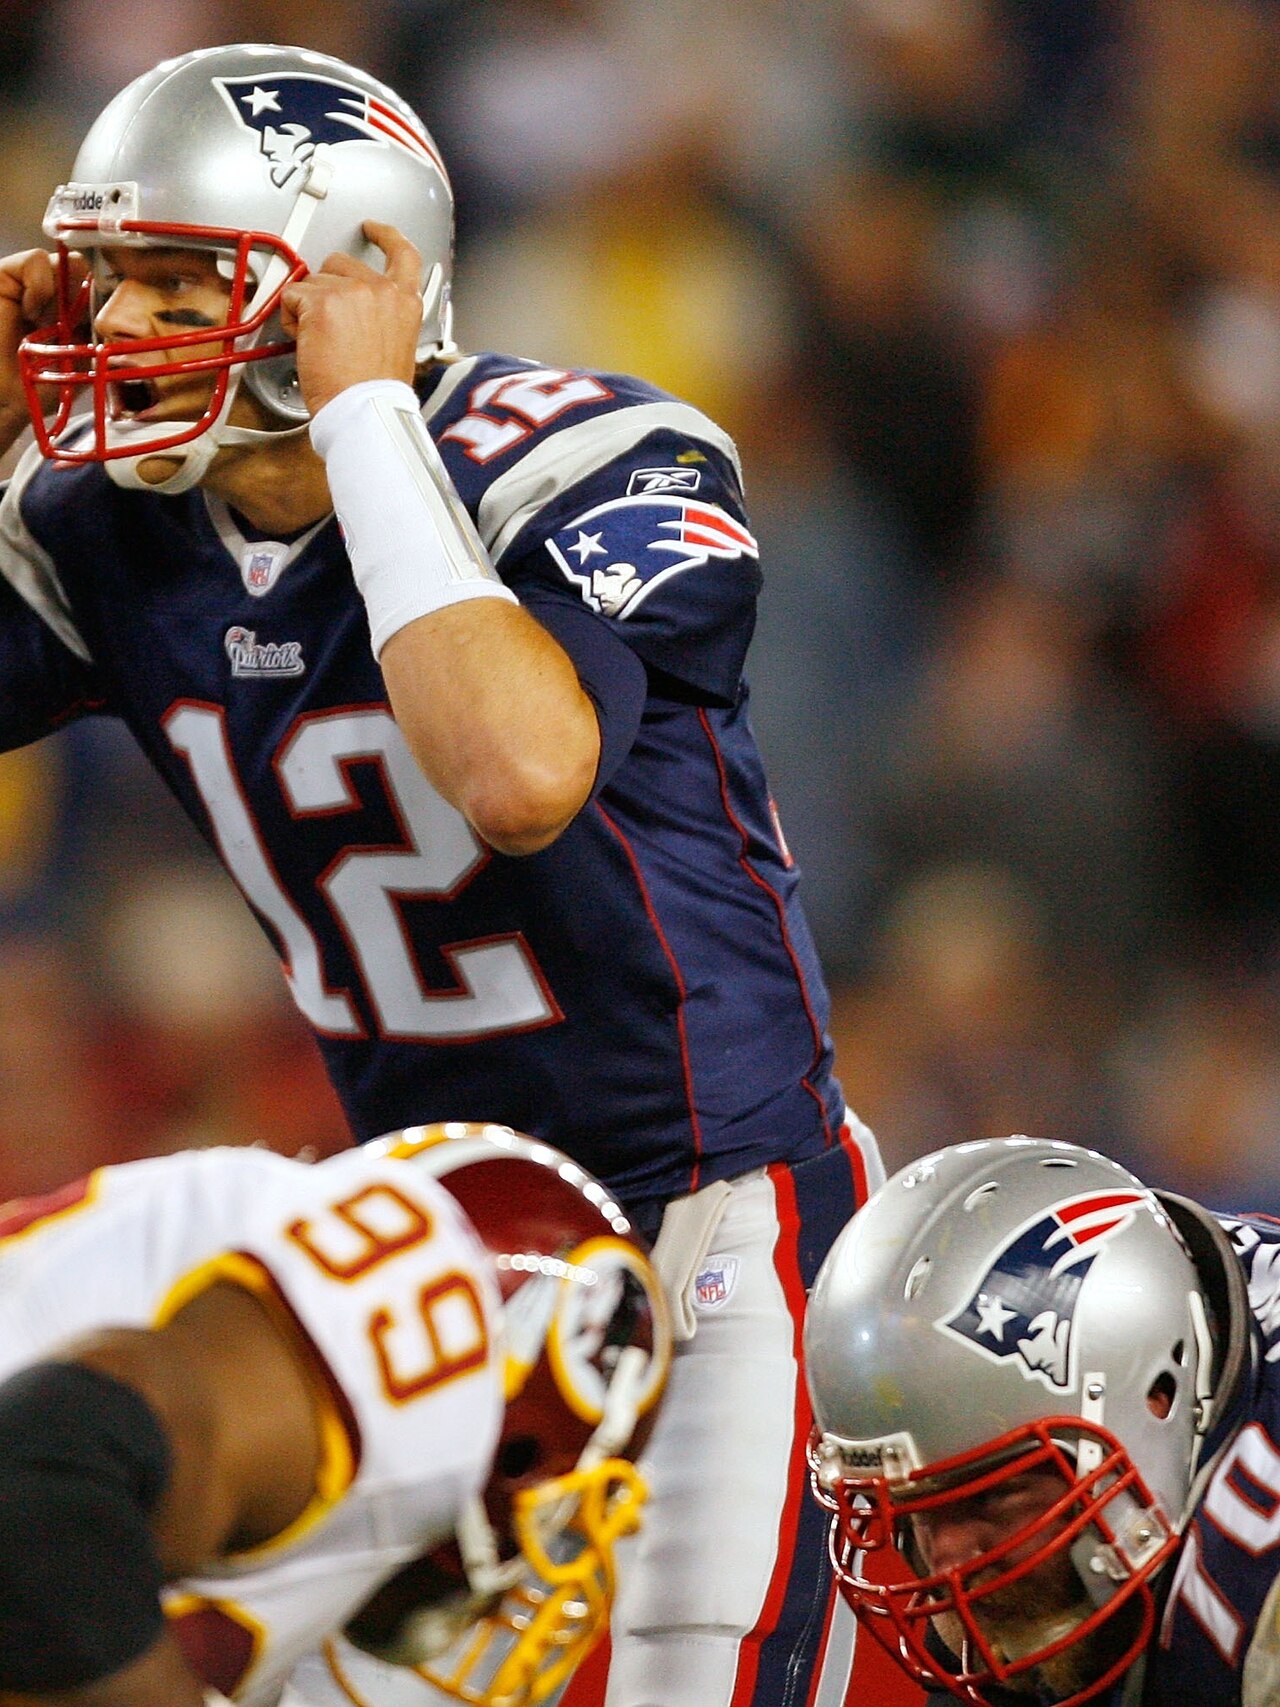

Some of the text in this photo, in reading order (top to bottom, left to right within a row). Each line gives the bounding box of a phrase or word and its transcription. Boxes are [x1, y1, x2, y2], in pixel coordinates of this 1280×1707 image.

[438, 370, 613, 465] 12
[226, 632, 304, 676] Patriots
[160, 697, 566, 1046] 12
[283, 1184, 491, 1409] 99
[1159, 1420, 1280, 1668] 70
